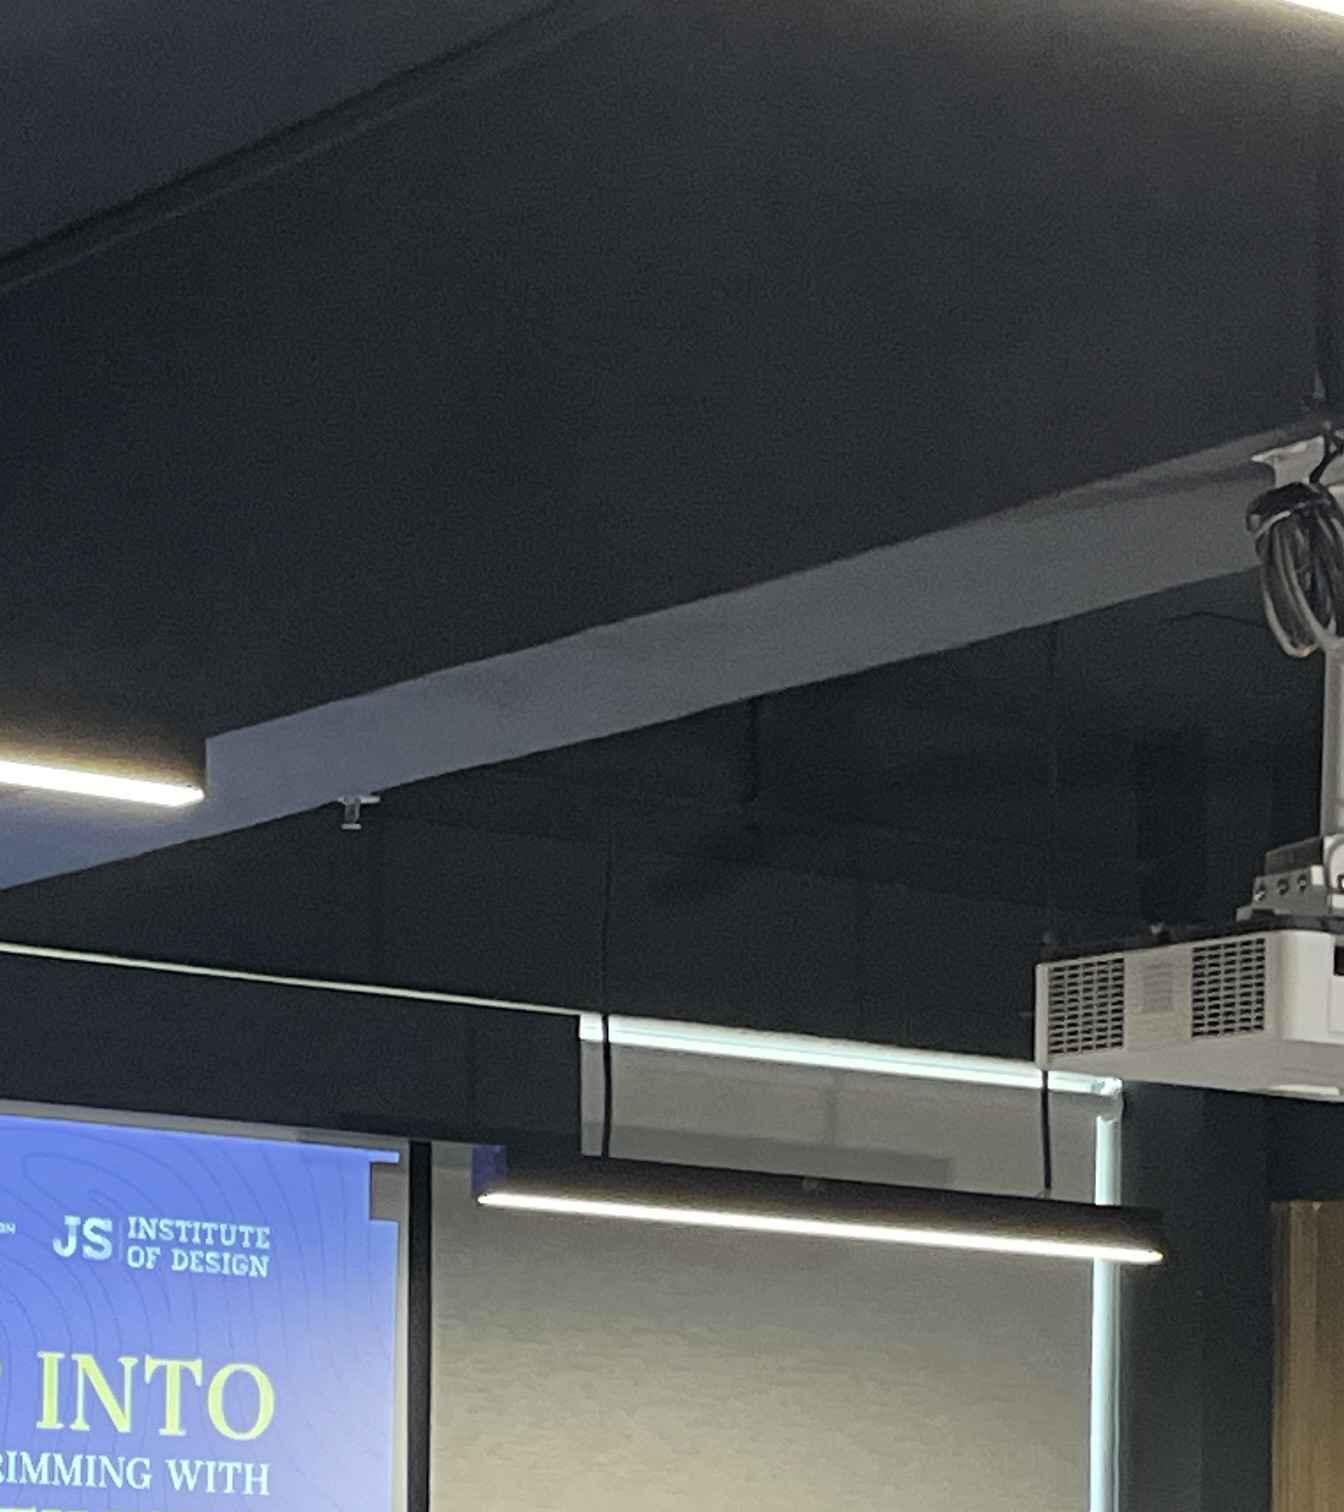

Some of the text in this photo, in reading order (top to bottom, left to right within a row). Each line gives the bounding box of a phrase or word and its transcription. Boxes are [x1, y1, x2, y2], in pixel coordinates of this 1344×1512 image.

[52, 1215, 113, 1261] JS
[127, 1216, 271, 1250] INSTITUTE
[127, 1246, 270, 1278] OF DESIGN
[36, 1350, 276, 1441] INTO
[165, 1458, 271, 1495] WITH
